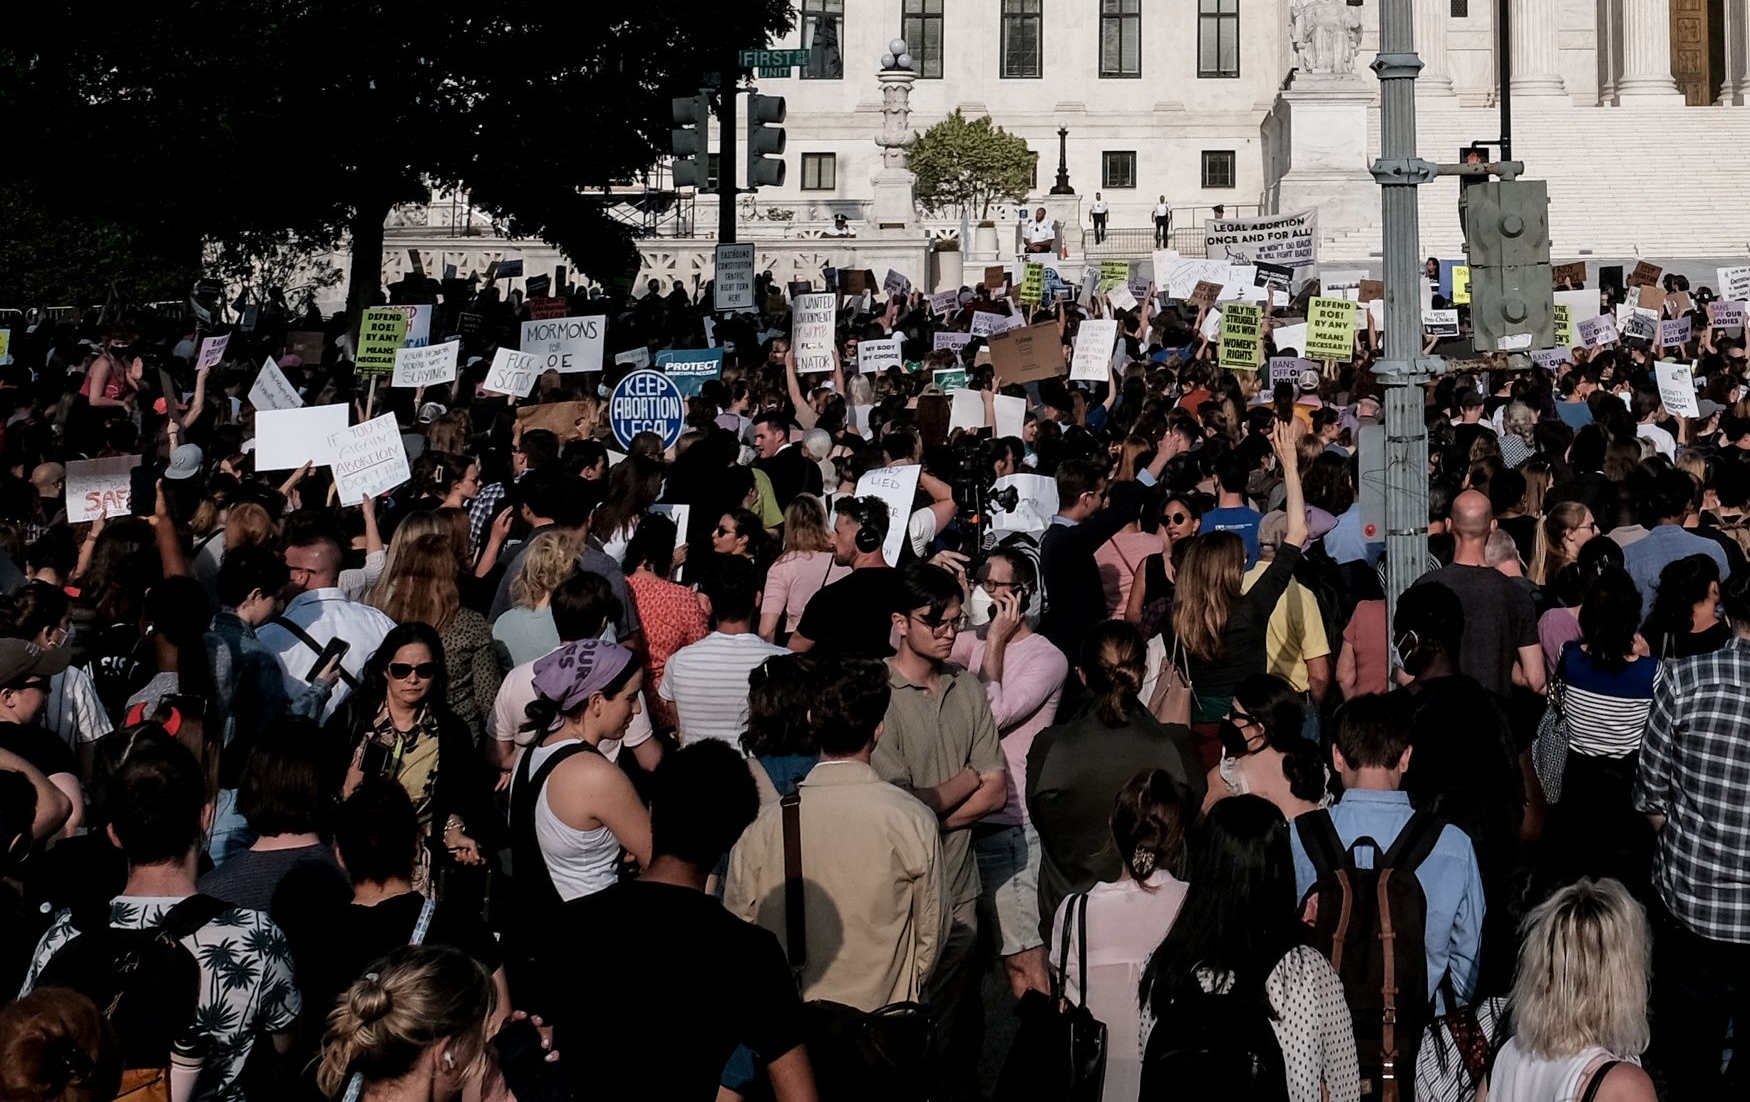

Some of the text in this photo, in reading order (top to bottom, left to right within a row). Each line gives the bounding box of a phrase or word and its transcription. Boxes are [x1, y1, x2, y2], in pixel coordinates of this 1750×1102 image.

[744, 51, 793, 66] FIRST
[760, 68, 790, 77] UNIT
[1214, 217, 1305, 233] LEGAL ABORTION
[1207, 235, 1238, 245] ONCE
[1242, 233, 1265, 244] AND
[1267, 230, 1289, 241] FOR
[725, 272, 746, 280] TRAFFIC
[1228, 305, 1257, 314] ONLY THE
[1315, 300, 1351, 309] DEFEND
[368, 312, 402, 321] DEFEND
[1225, 314, 1259, 326] STRUGGLE
[1319, 310, 1344, 320] ROE!
[371, 323, 395, 332] ROE!
[1226, 324, 1256, 335] HAS WON
[1314, 320, 1349, 329] BY ANY
[366, 333, 399, 342] BY ANY
[527, 321, 597, 342] MORMONS
[1315, 332, 1344, 341] MEANS
[1223, 338, 1257, 350] WOMEN'S
[1306, 340, 1352, 351] NECESSARY!
[366, 347, 394, 355] MEANS
[1226, 349, 1253, 361] RIGHTS
[357, 356, 396, 364] NECESSAR
[506, 353, 534, 370] FUCK
[540, 354, 573, 368] OE
[665, 359, 719, 371] PROTECT
[795, 354, 831, 371] ENATOR
[1272, 360, 1295, 368] BANS
[401, 366, 447, 384] SLAYING
[1272, 369, 1289, 377] OFF
[625, 374, 667, 396] KEEP
[614, 397, 680, 419] ABORTION
[621, 419, 675, 441] LEGAL
[327, 432, 340, 449] IF
[336, 445, 399, 475] ABORTION
[871, 476, 900, 490] LIED
[85, 489, 131, 513] SAF
[575, 640, 598, 681] OUR
